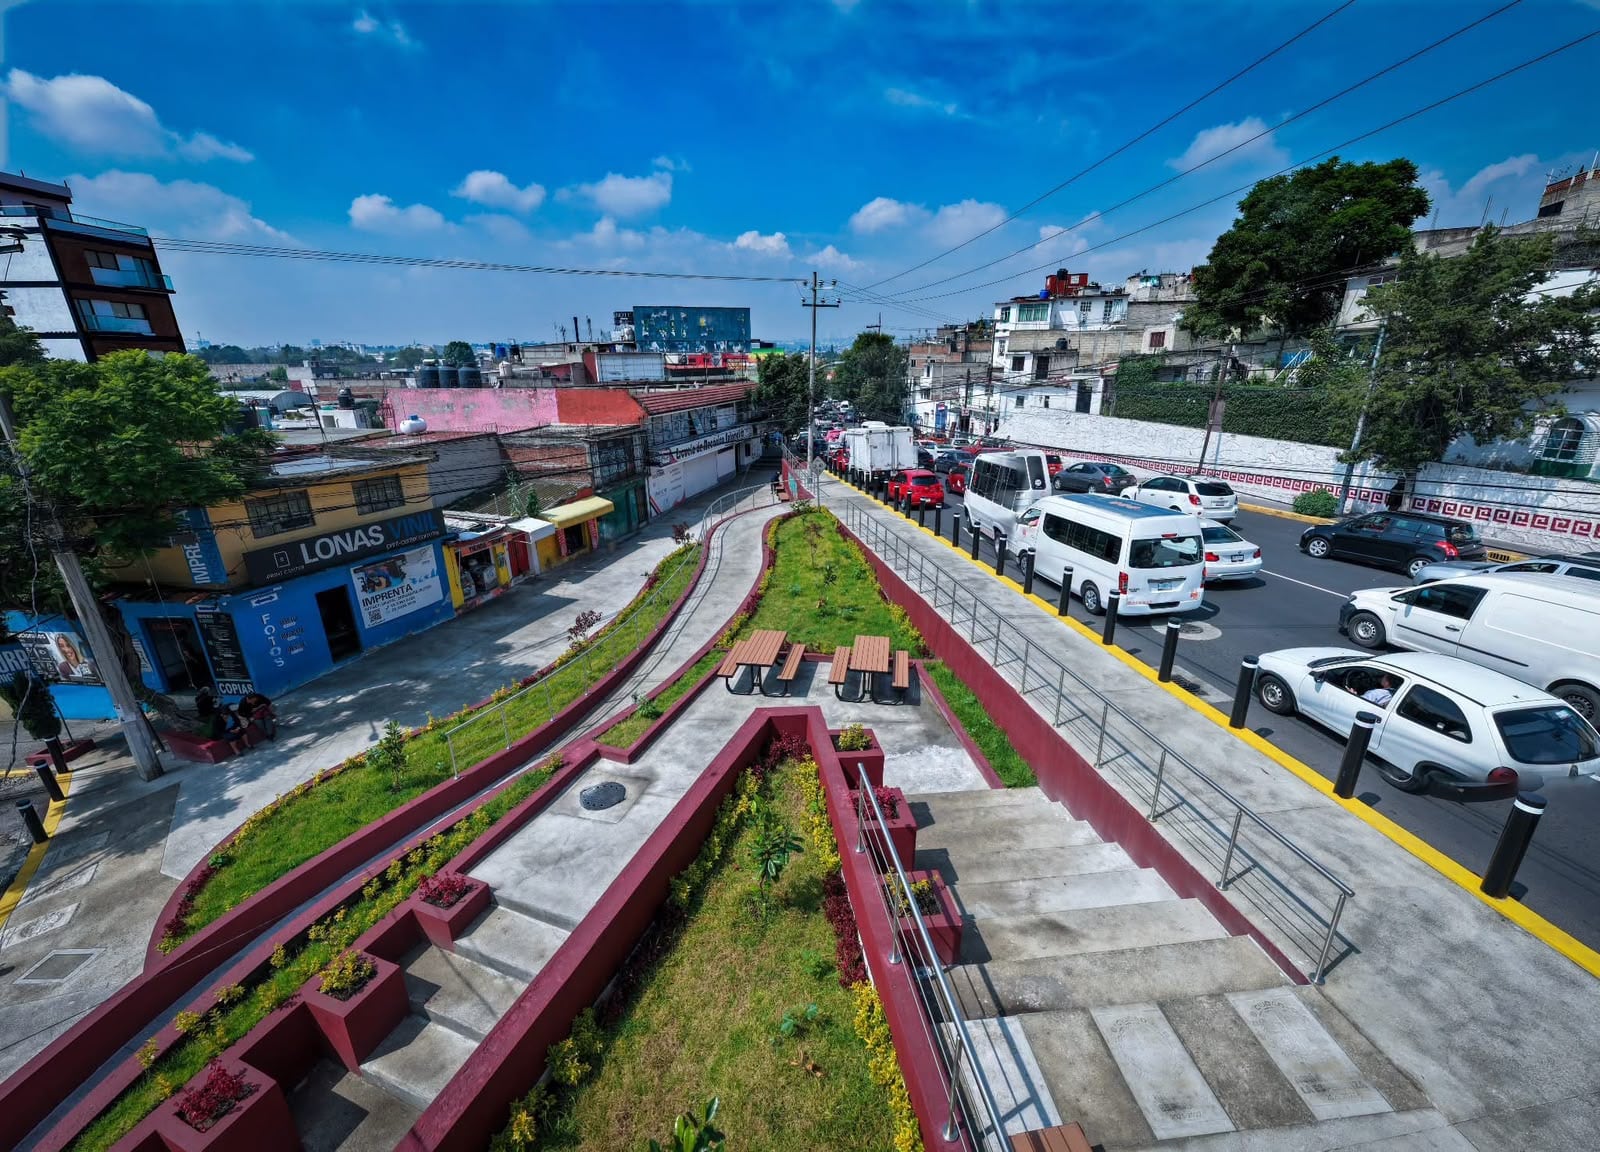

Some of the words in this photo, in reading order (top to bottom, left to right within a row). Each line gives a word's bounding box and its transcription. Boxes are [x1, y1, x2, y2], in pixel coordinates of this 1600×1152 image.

[300, 526, 385, 565] LONAS
[386, 512, 439, 539] VINIL
[362, 584, 413, 607] IMPRENTA
[261, 613, 285, 667] FOTOS
[218, 683, 255, 696] COPIAS
